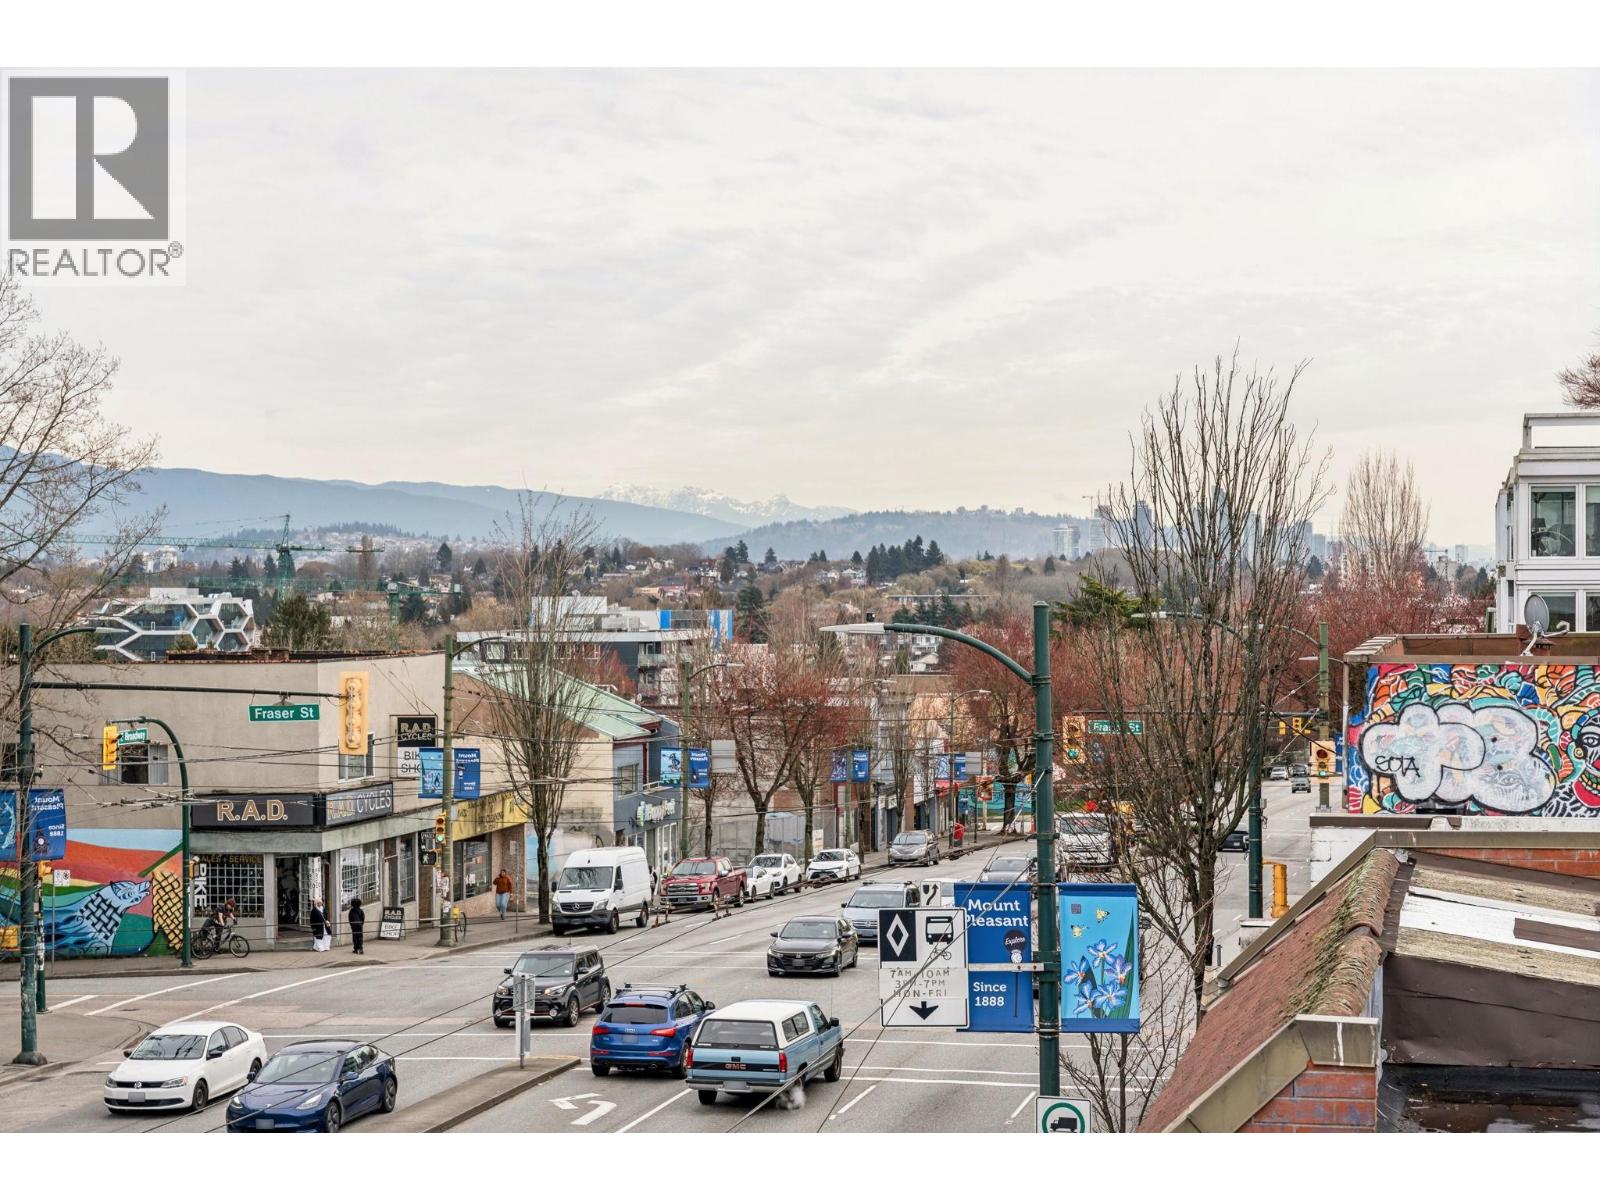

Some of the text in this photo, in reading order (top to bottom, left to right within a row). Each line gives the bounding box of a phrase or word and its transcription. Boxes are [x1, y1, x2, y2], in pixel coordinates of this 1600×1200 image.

[255, 707, 314, 720] Fraser St
[125, 731, 146, 743] Broadway
[404, 751, 420, 761] BIK
[356, 789, 391, 813] CYCLES
[216, 799, 289, 822] R.A.D.
[967, 899, 1021, 911] Mount
[973, 981, 1007, 992] Since
[974, 996, 1005, 1007] 1888
